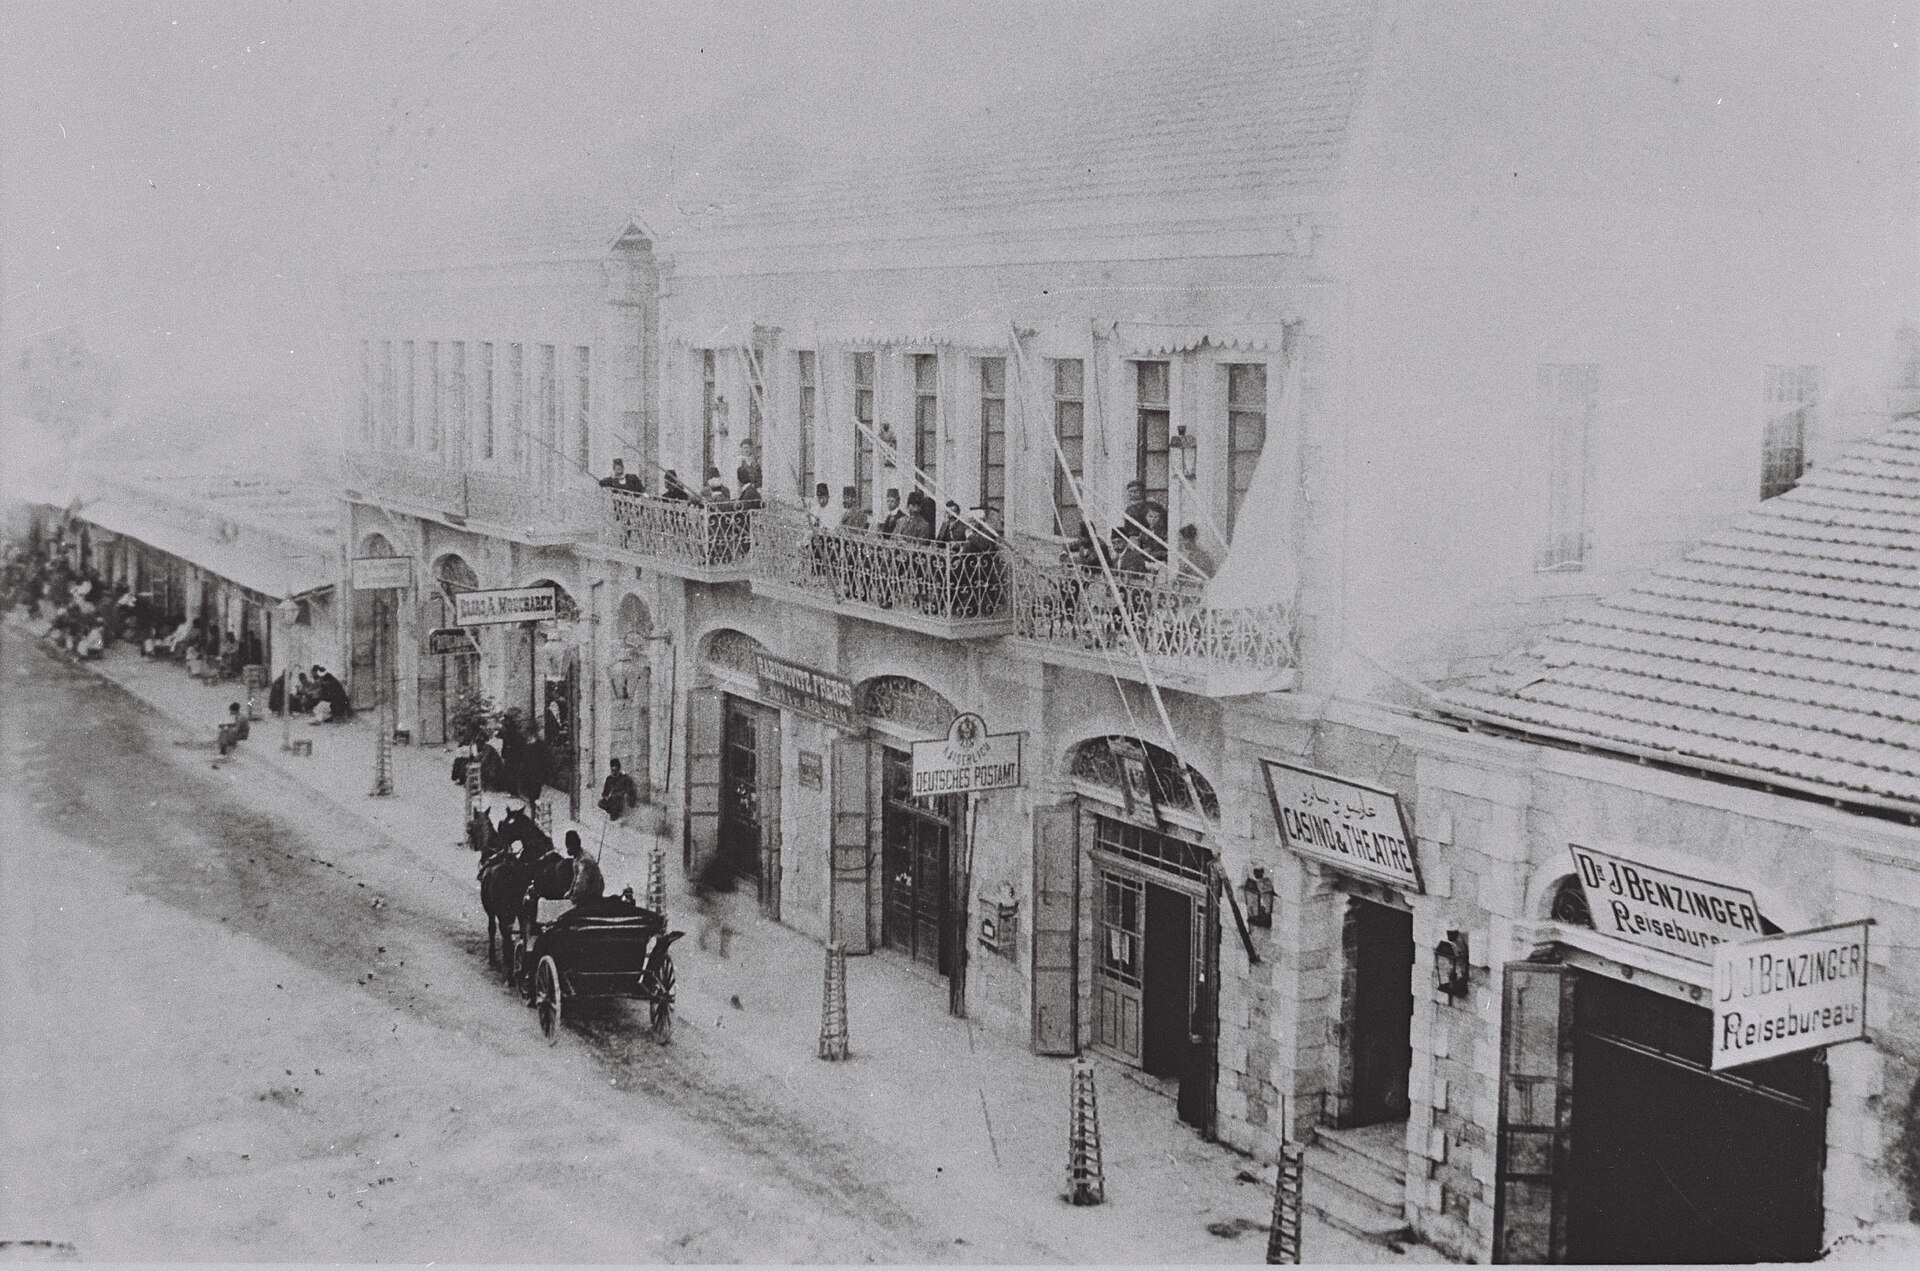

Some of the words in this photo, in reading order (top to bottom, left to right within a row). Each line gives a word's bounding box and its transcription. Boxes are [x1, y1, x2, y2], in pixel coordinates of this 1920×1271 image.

[916, 767, 971, 793] DEUTSCHES
[974, 763, 1016, 787] POSTAMT
[1283, 807, 1337, 851] CASINO
[1335, 831, 1350, 854] &
[1342, 823, 1413, 874] THEATRE
[1719, 1003, 1859, 1052] Reisebureau
